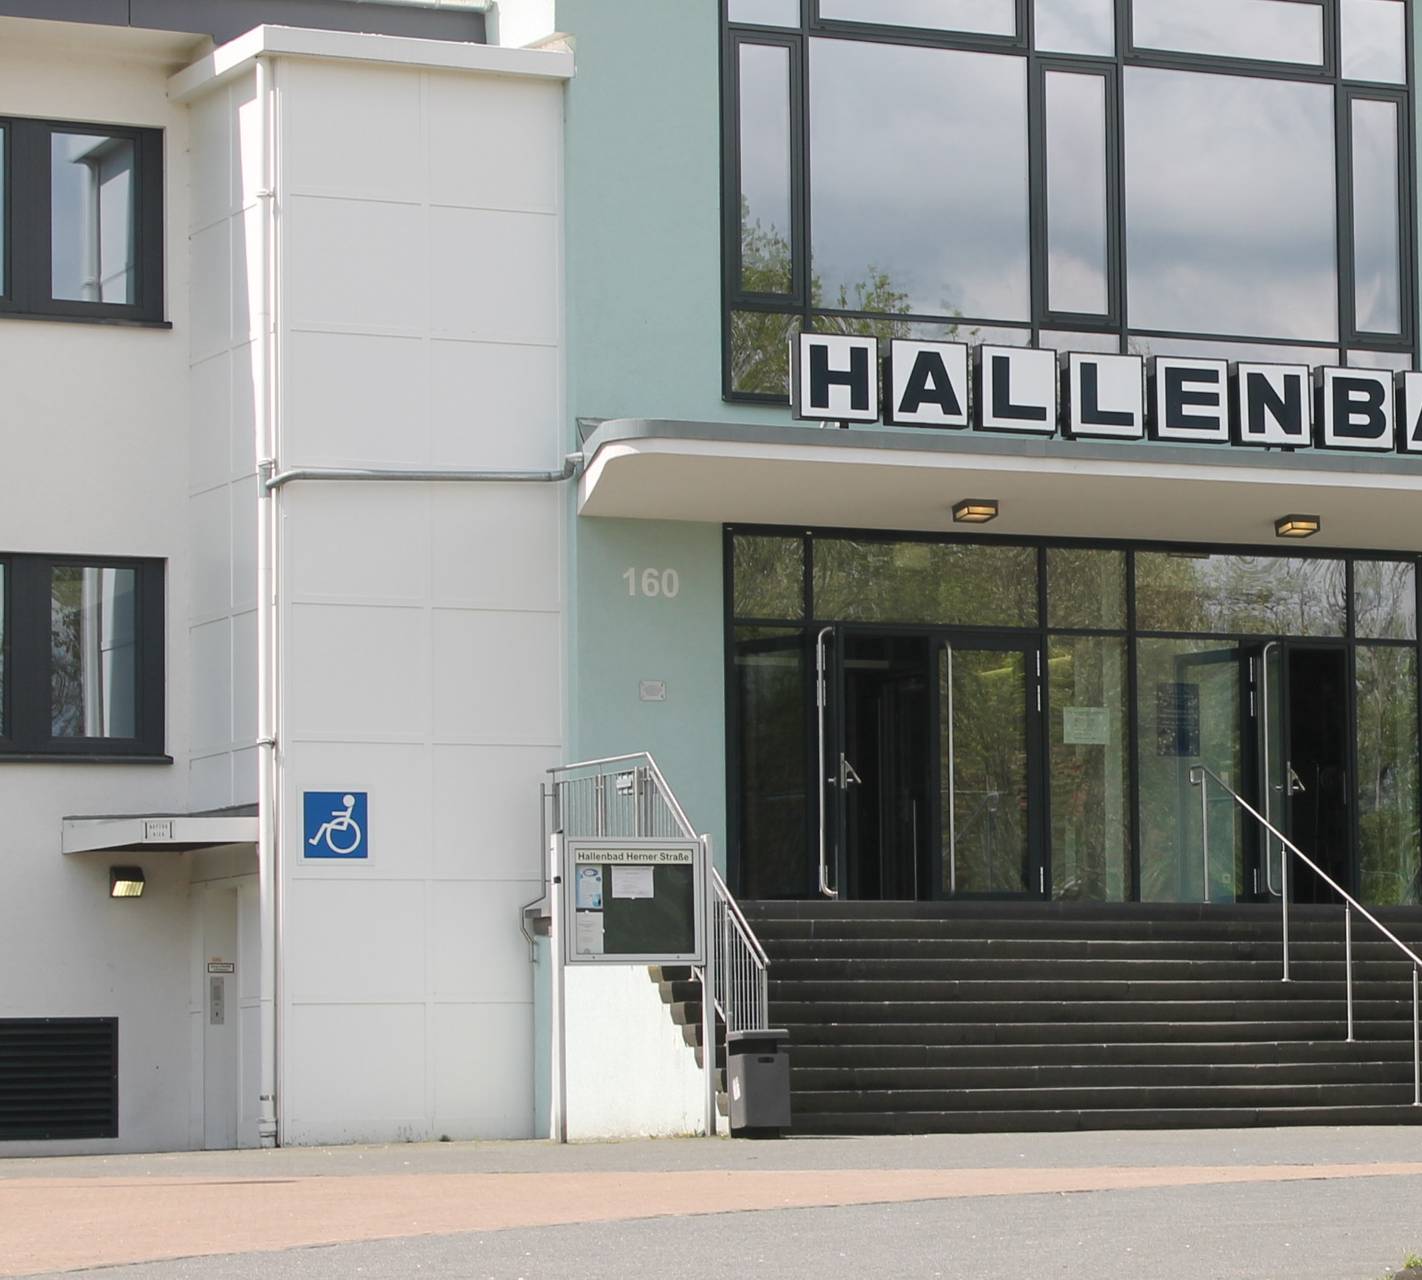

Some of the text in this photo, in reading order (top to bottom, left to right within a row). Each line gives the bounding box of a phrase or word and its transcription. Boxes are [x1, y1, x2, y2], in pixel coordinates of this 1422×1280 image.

[622, 566, 680, 598] 160
[577, 851, 690, 861] Hallenbad Herner Straße
